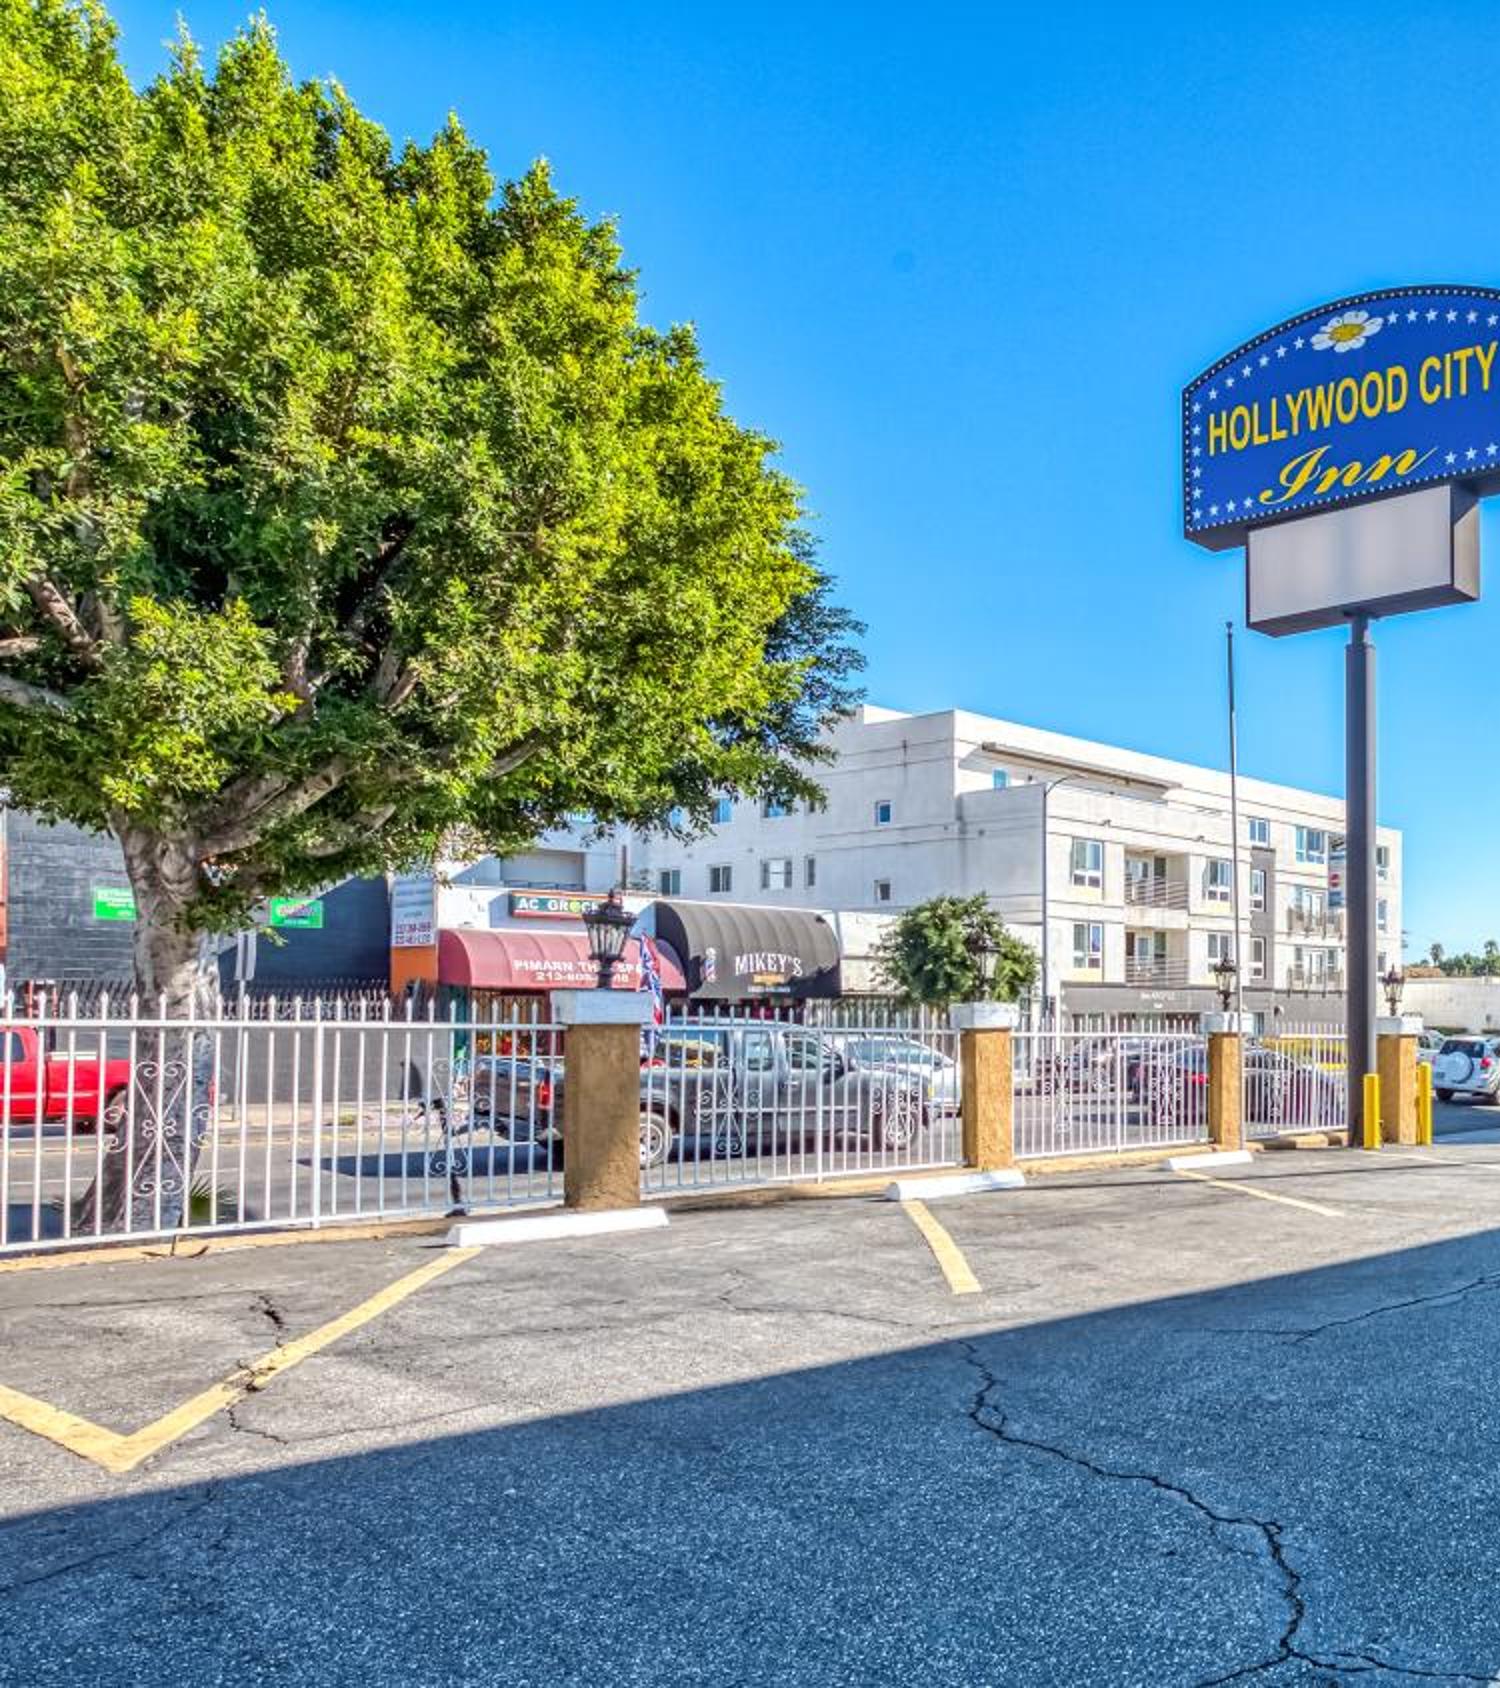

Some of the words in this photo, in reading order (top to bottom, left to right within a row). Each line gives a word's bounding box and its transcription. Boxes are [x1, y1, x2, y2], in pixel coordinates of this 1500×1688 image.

[1206, 365, 1410, 457] HOLLYWOOD
[1418, 341, 1499, 405] CITY
[1259, 444, 1438, 506] Inn
[518, 898, 539, 909] AC
[734, 952, 803, 977] MIKEY'S
